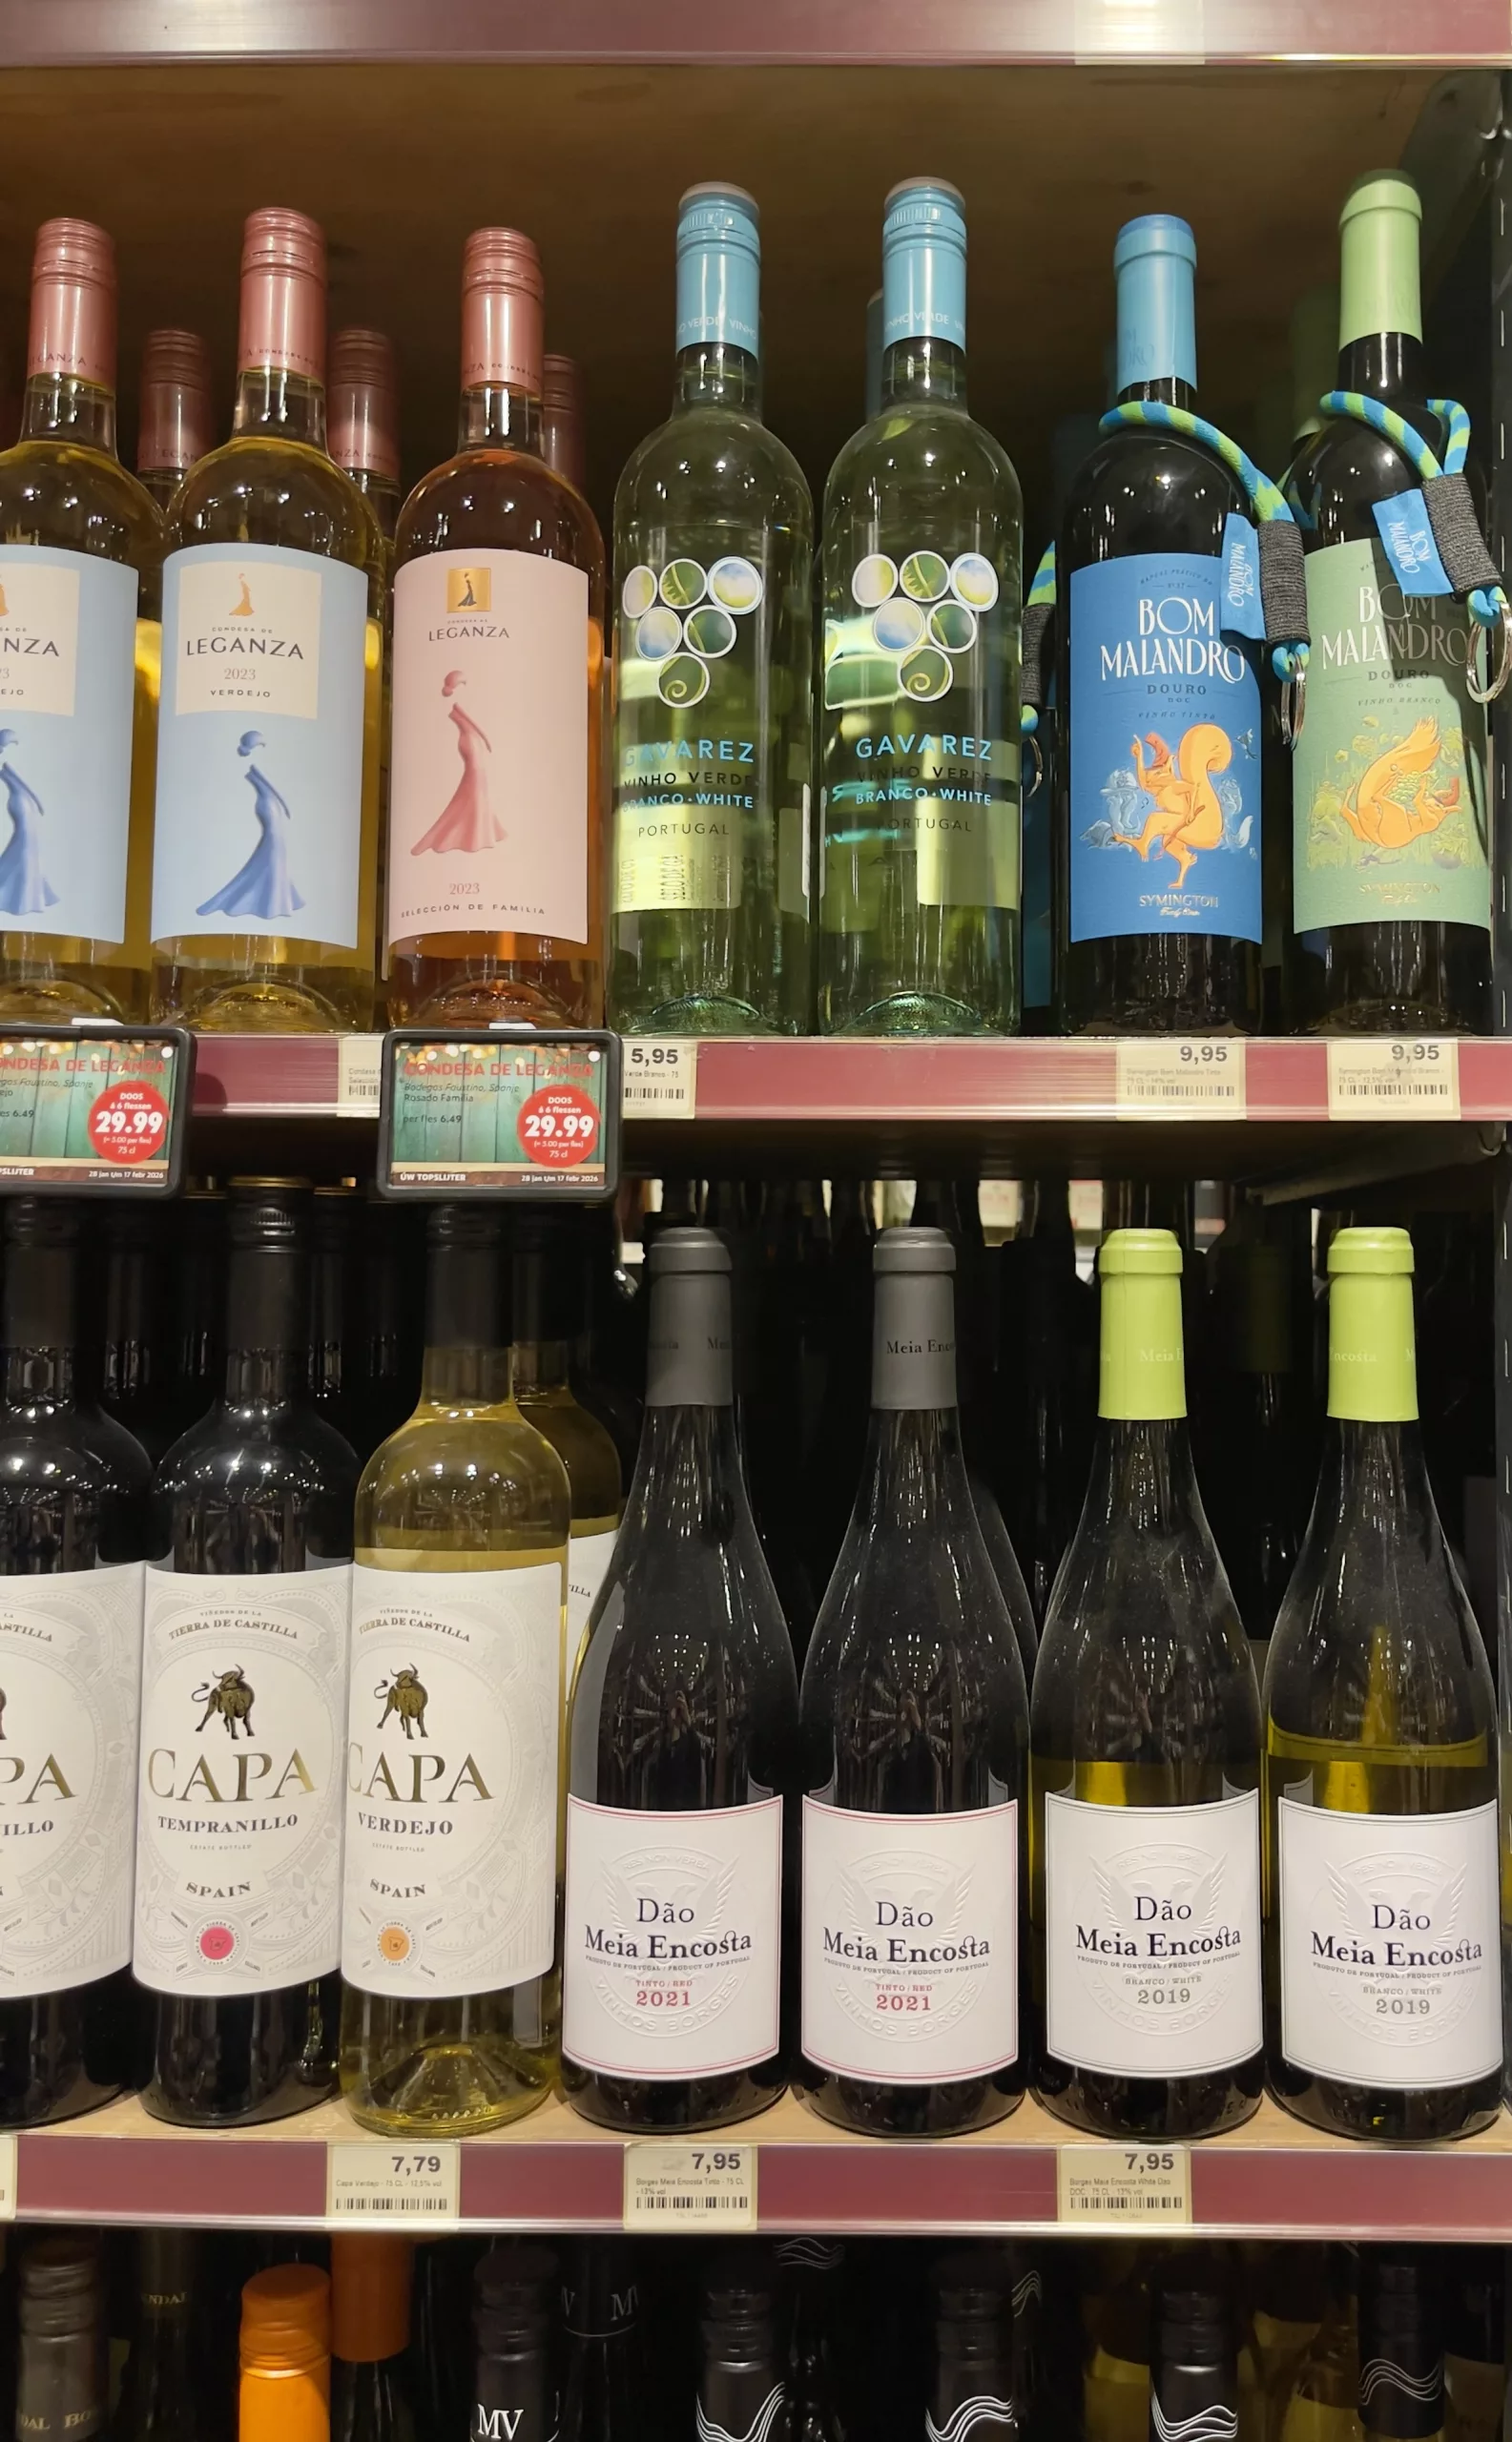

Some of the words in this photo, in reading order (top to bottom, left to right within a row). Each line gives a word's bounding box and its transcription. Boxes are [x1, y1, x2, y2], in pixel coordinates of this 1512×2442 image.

[1359, 583, 1437, 624] BOM
[1138, 596, 1214, 637] BOM
[428, 626, 510, 642] LEGANZA
[187, 636, 303, 660] LEGANZA
[1321, 623, 1469, 671] MALANDRO
[1100, 637, 1245, 684] MALANDRO
[224, 668, 257, 680] 2023
[1368, 670, 1430, 681] DOURO
[210, 689, 271, 698] VERDEJO
[1147, 683, 1207, 695] DOURO
[625, 739, 754, 767] GAVAREZ
[856, 734, 992, 761] GAVAREZ
[624, 772, 676, 790] VINHO
[695, 794, 754, 809] WHITE
[856, 787, 928, 805] BRANCO
[940, 788, 992, 806] WHITE
[638, 822, 730, 838] PORTUGAL
[449, 882, 480, 895] 2023
[492, 903, 546, 915] FAMILIA
[1139, 894, 1218, 908] SYMINGTON
[631, 1047, 679, 1067] 5,95
[1180, 1045, 1228, 1065] 9,95
[1391, 1044, 1440, 1065] 9,95
[66, 1059, 87, 1071] DE
[92, 1059, 165, 1075] LEGANZA
[404, 1063, 485, 1076] CONDESA
[490, 1063, 511, 1076] DE
[516, 1063, 594, 1077] LEGANZA
[119, 1092, 144, 1101] DOOS
[404, 1093, 439, 1103] Rosado
[441, 1094, 474, 1103] Familia
[548, 1096, 572, 1105] DOOS
[12, 1108, 35, 1118] 6.49
[94, 1110, 164, 1134] 29.99
[440, 1114, 463, 1124] 6.49
[525, 1114, 594, 1138] 29.99
[117, 1146, 127, 1154] 75
[549, 1149, 559, 1158] 75
[417, 1173, 466, 1182] TOPSLIJTER
[886, 1339, 922, 1355] Meia
[1139, 1348, 1174, 1363] Meia
[168, 1621, 210, 1641] TIERRA
[214, 1619, 232, 1628] DE
[235, 1619, 299, 1640] CASTILLA
[359, 1618, 389, 1635] TIERRA
[391, 1617, 406, 1626] DE
[409, 1618, 471, 1643] CASTILLA
[148, 1748, 320, 1804] CAPA
[347, 1742, 496, 1804] CAPA
[157, 1813, 299, 1833] TEMPRANILLO
[358, 1811, 454, 1835] VERDEJO
[186, 1880, 252, 1898] SPAIN
[369, 1878, 426, 1898] SPAIN
[636, 1897, 694, 1924] Dão
[875, 1901, 934, 1928] Dão
[1133, 1895, 1192, 1921] Dão
[1372, 1904, 1431, 1931] Dão
[584, 1924, 639, 1957] Meia
[647, 1930, 753, 1959] Encosta
[823, 1927, 878, 1961] Meia
[886, 1935, 991, 1963] Encosta
[1075, 1924, 1138, 1956] Meia
[1147, 1926, 1241, 1957] Encosta
[1311, 1931, 1376, 1965] Meia
[1384, 1938, 1482, 1967] Encosta
[635, 1979, 666, 1988] TINTO
[673, 1979, 693, 1988] RED
[876, 1983, 905, 1992] TINTO
[1172, 1976, 1202, 1984] WHITE
[636, 1990, 691, 2007] 2021
[1137, 1988, 1191, 2004] 2019
[1362, 1986, 1404, 1996] BRANCO
[1411, 1987, 1442, 1996] WHITE
[876, 1994, 932, 2011] 2021
[1376, 1998, 1431, 2015] 2019
[391, 2156, 442, 2176] 7,79
[692, 2152, 741, 2174] 7,95
[1125, 2152, 1174, 2174] 7,95
[636, 2178, 658, 2186] Borges
[477, 2403, 524, 2441] MV
